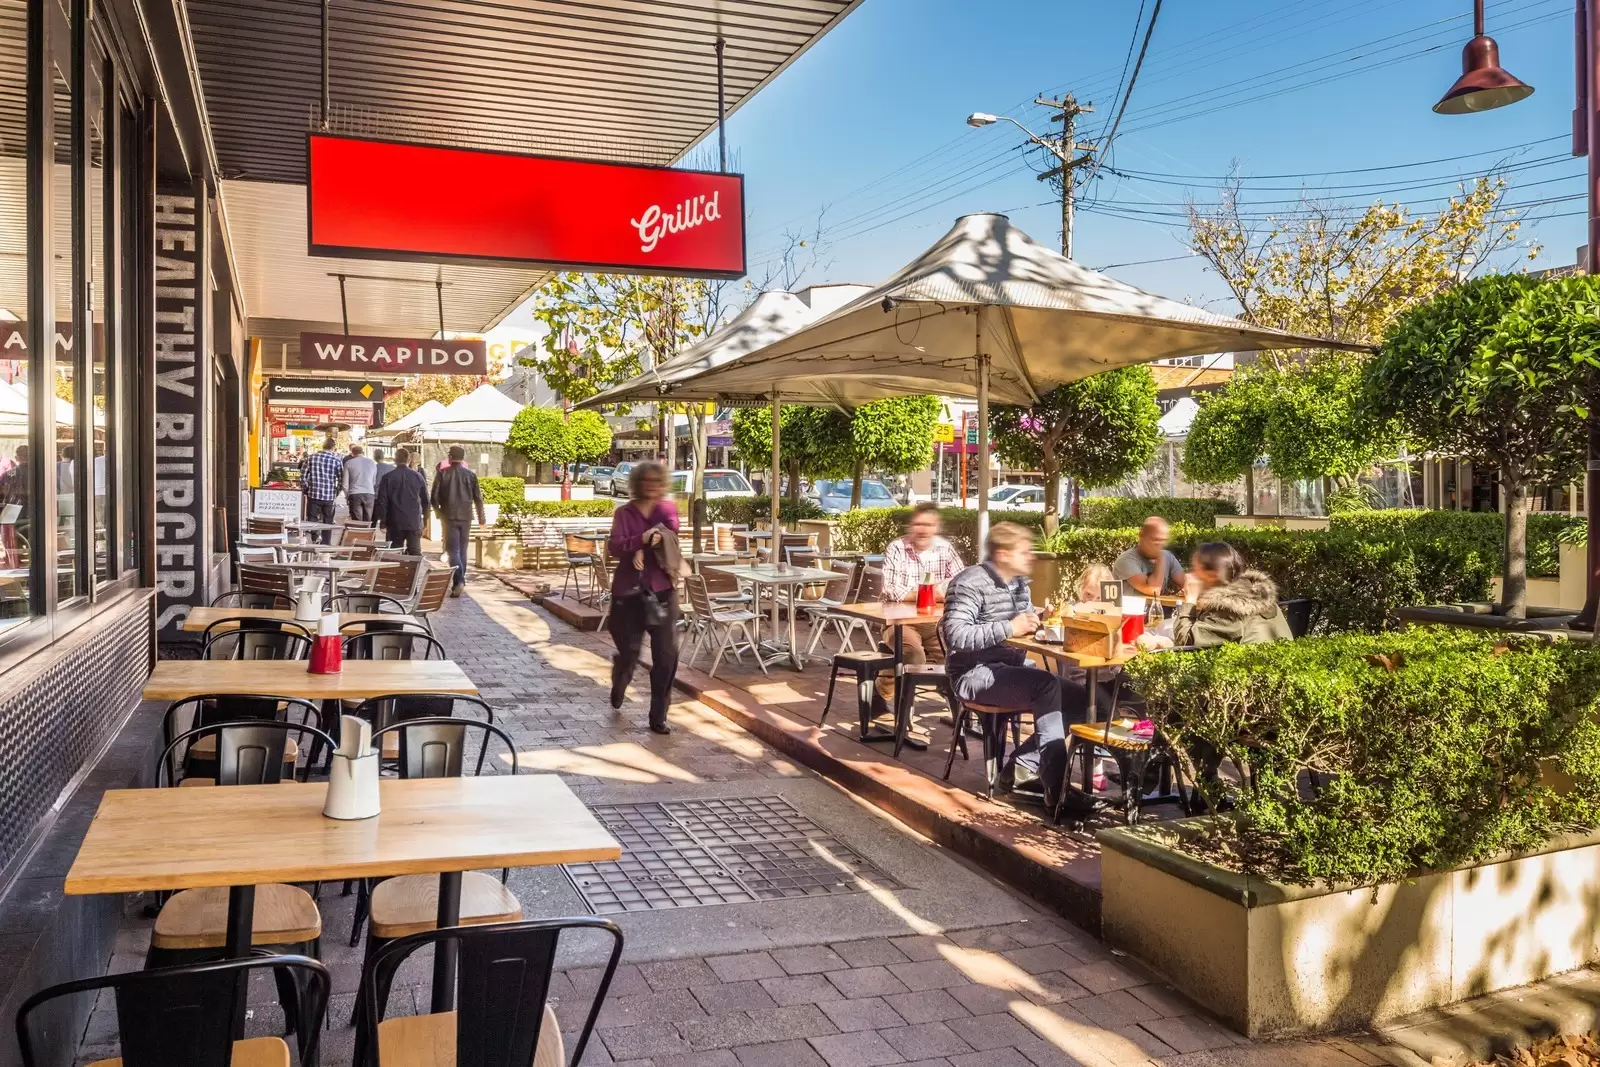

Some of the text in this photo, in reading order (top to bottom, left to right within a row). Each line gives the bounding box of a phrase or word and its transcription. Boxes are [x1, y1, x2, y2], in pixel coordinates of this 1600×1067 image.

[630, 190, 721, 253] Grill'd
[314, 342, 475, 367] WRAPIDO
[274, 385, 352, 395] CommonwealthBank
[155, 194, 196, 630] HEALTHY BURGERS
[936, 425, 950, 436] 25
[1104, 584, 1118, 600] 10
